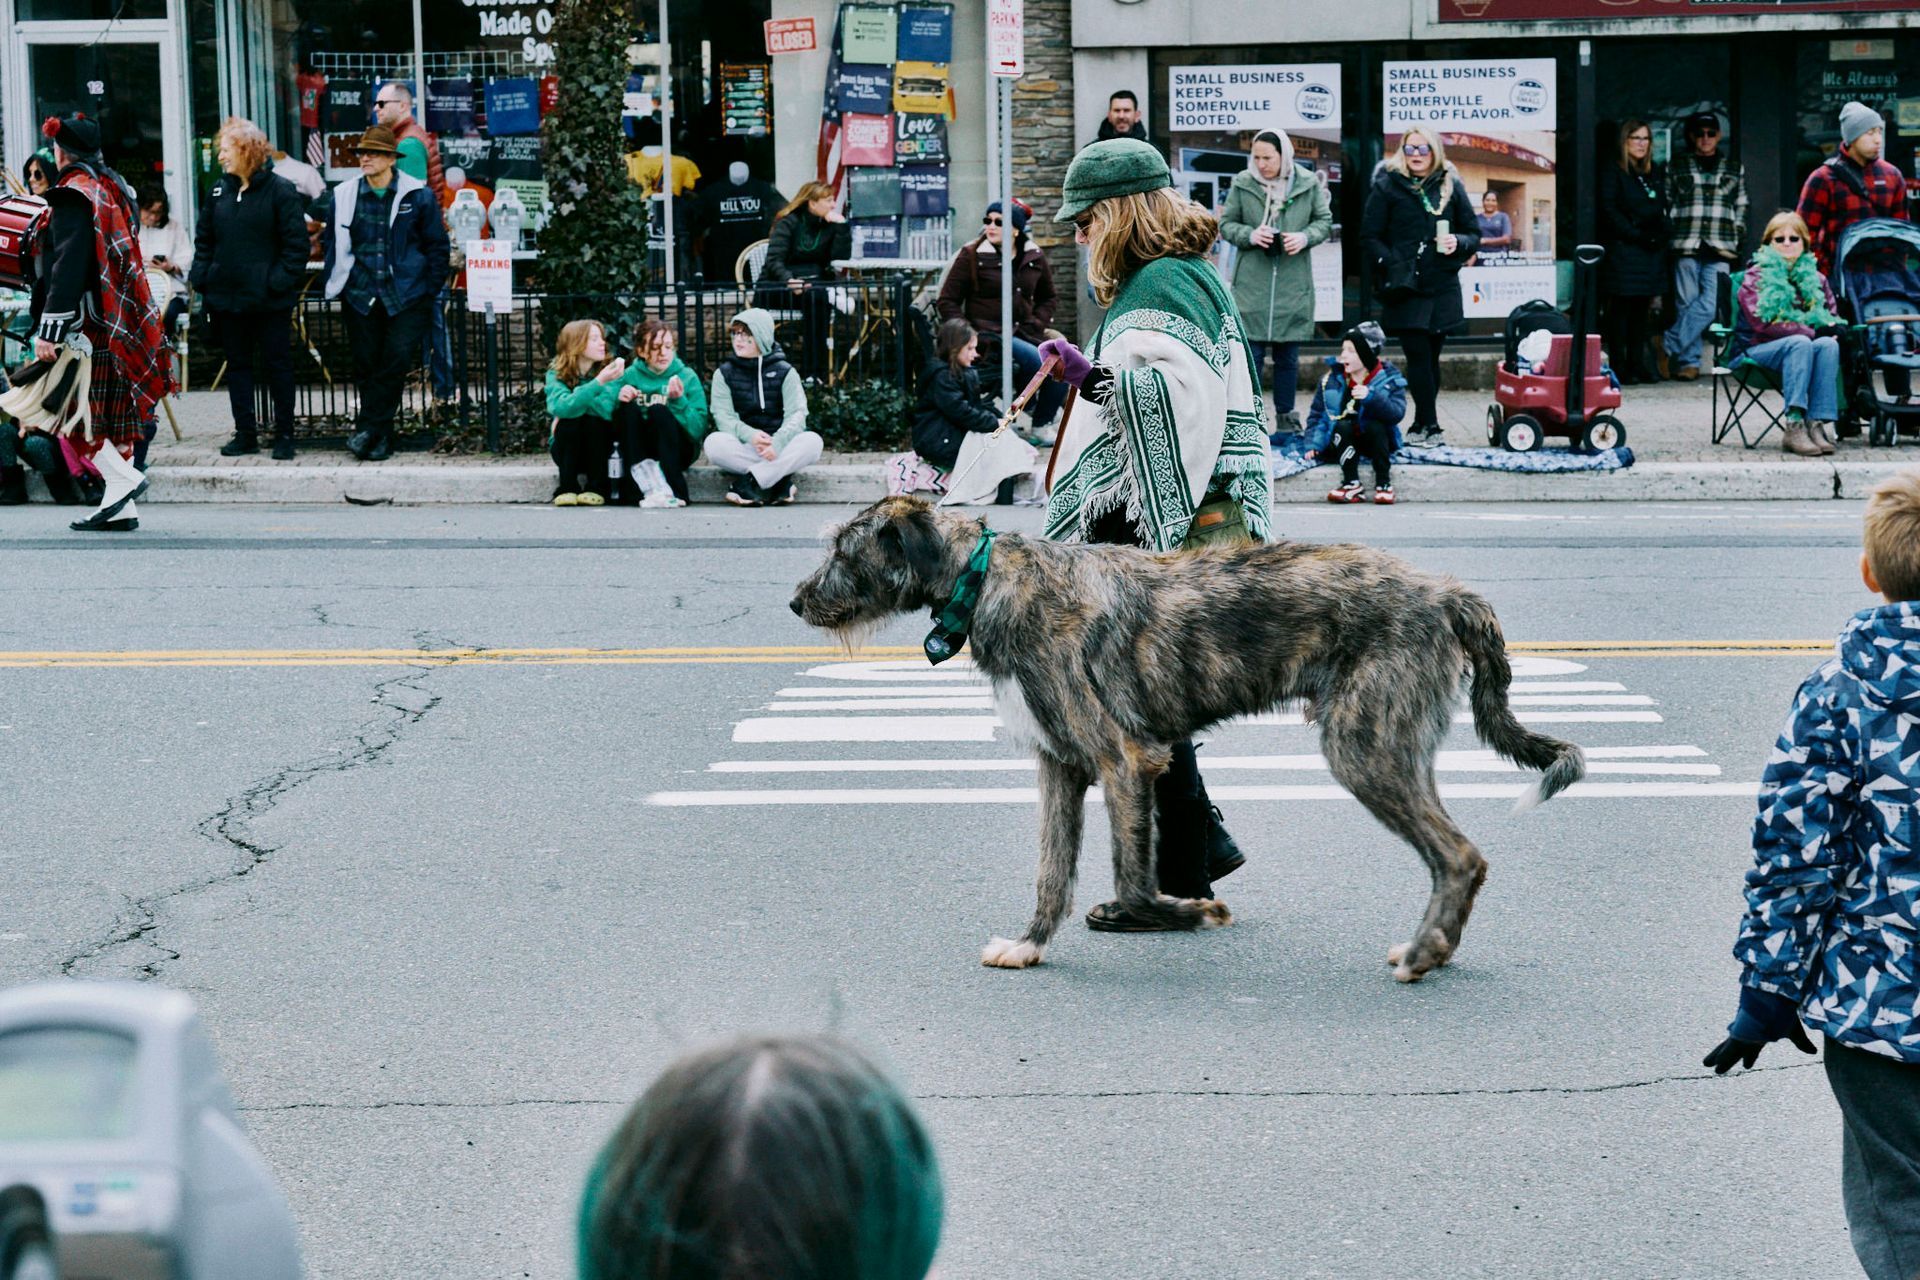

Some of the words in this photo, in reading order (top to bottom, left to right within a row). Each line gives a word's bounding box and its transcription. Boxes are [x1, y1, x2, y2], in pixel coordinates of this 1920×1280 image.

[479, 10, 532, 36] Made
[536, 8, 555, 34] O
[992, 12, 1020, 28] PARKING
[770, 30, 812, 50] CLOSED
[1176, 74, 1225, 84] SMALL
[1230, 72, 1304, 84] BUSINESS
[1390, 70, 1438, 80] SMALL
[1442, 67, 1516, 78] BUSINESS
[86, 80, 104, 94] 12
[1176, 88, 1223, 98] KEEPS
[1390, 83, 1436, 93] KEEPS
[1176, 100, 1271, 112] SOMERVILLE
[1390, 96, 1483, 107] SOMERVILLE
[1176, 114, 1240, 126] ROOTED.
[1390, 110, 1425, 120] FULL
[1430, 109, 1448, 120] OF
[1452, 108, 1514, 120] FLAVOR.
[897, 112, 936, 139] Love
[896, 139, 942, 154] GENDER
[720, 200, 739, 211] KILL
[740, 198, 760, 210] YOU
[468, 259, 510, 269] PARKING
